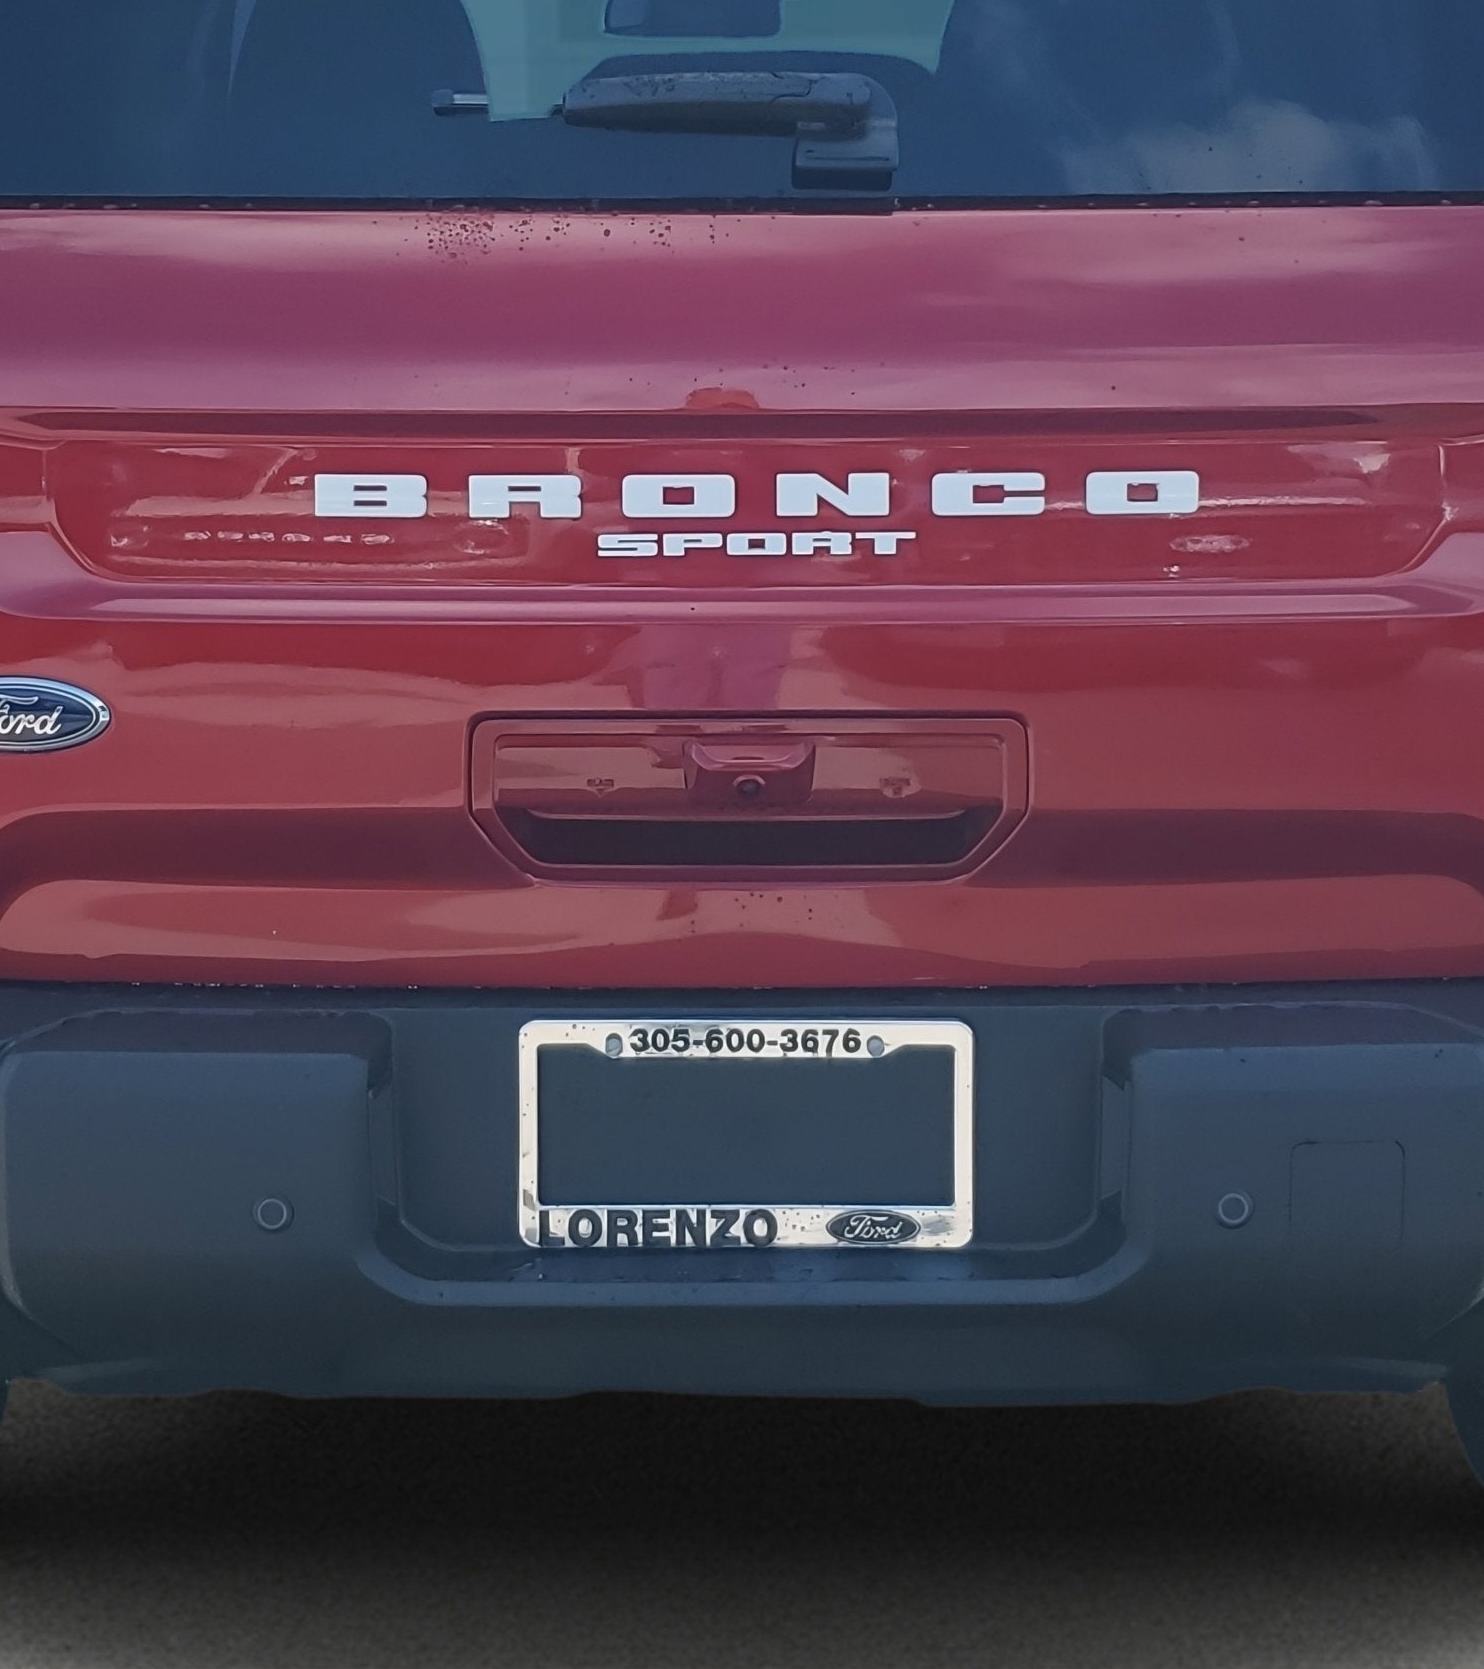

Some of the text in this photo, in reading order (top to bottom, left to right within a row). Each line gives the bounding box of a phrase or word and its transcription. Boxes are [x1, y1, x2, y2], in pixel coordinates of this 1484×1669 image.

[313, 469, 1201, 519] BRONCO
[596, 530, 917, 558] SPORT
[629, 1028, 863, 1055] 305-600-3676
[538, 1208, 903, 1248] LORENZO Ford
